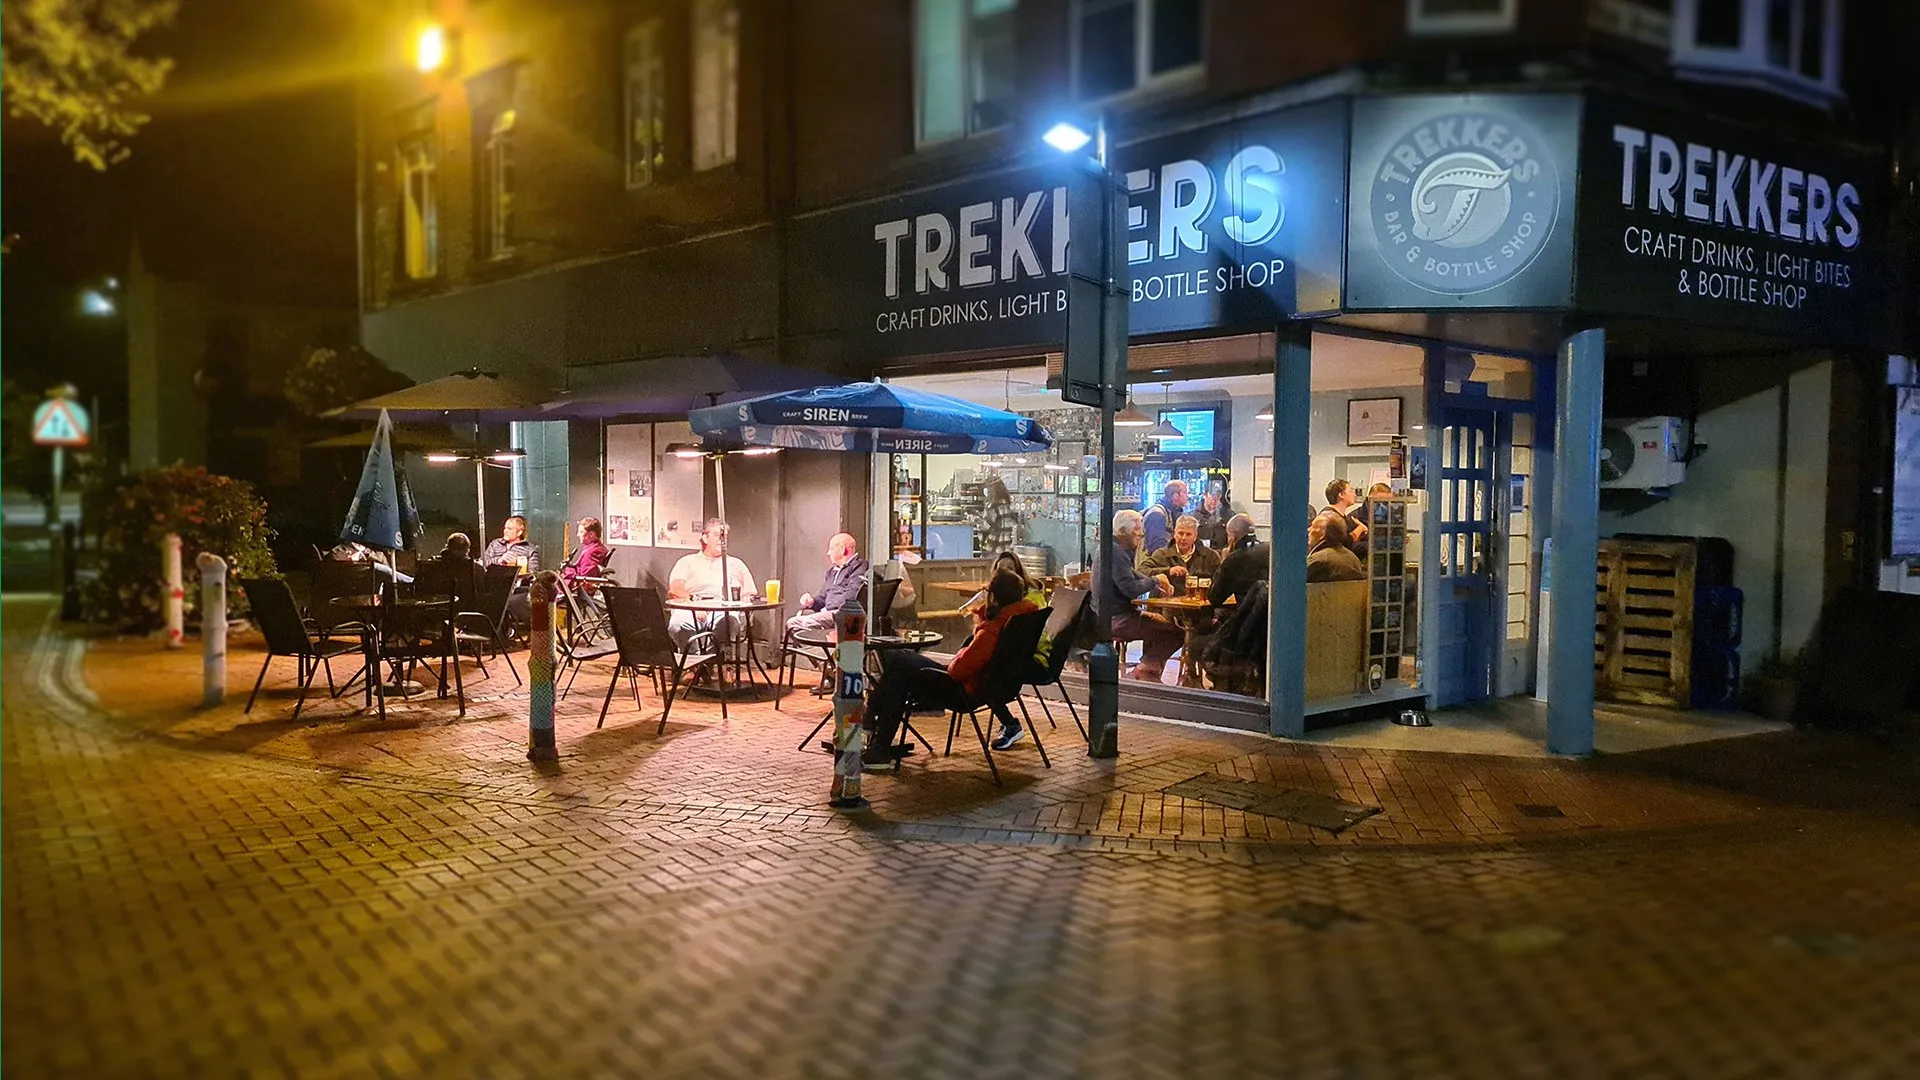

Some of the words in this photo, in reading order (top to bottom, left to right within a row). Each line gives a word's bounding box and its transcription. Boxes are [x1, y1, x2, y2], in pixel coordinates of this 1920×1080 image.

[1380, 116, 1541, 185] TREKKERS
[1613, 124, 1861, 250] TREKKERS
[1384, 210, 1408, 246] BAR
[1423, 255, 1498, 277] BOTTLE
[1502, 211, 1538, 259] SHOP
[1623, 226, 1687, 261] CRAFT
[1691, 238, 1760, 276] DRINKS,
[1765, 252, 1810, 282] LIGHT
[1815, 261, 1851, 289] BITES
[1131, 269, 1209, 303] BOTTLE
[1215, 259, 1286, 293] SHOP
[1678, 269, 1691, 295] &
[1698, 270, 1758, 304] BOTTLE
[1763, 281, 1807, 310] SHOP
[876, 307, 925, 335] CRAFT
[929, 299, 994, 327] DRINKS,
[999, 291, 1051, 319] LIGHT
[803, 408, 850, 421] SIREN
